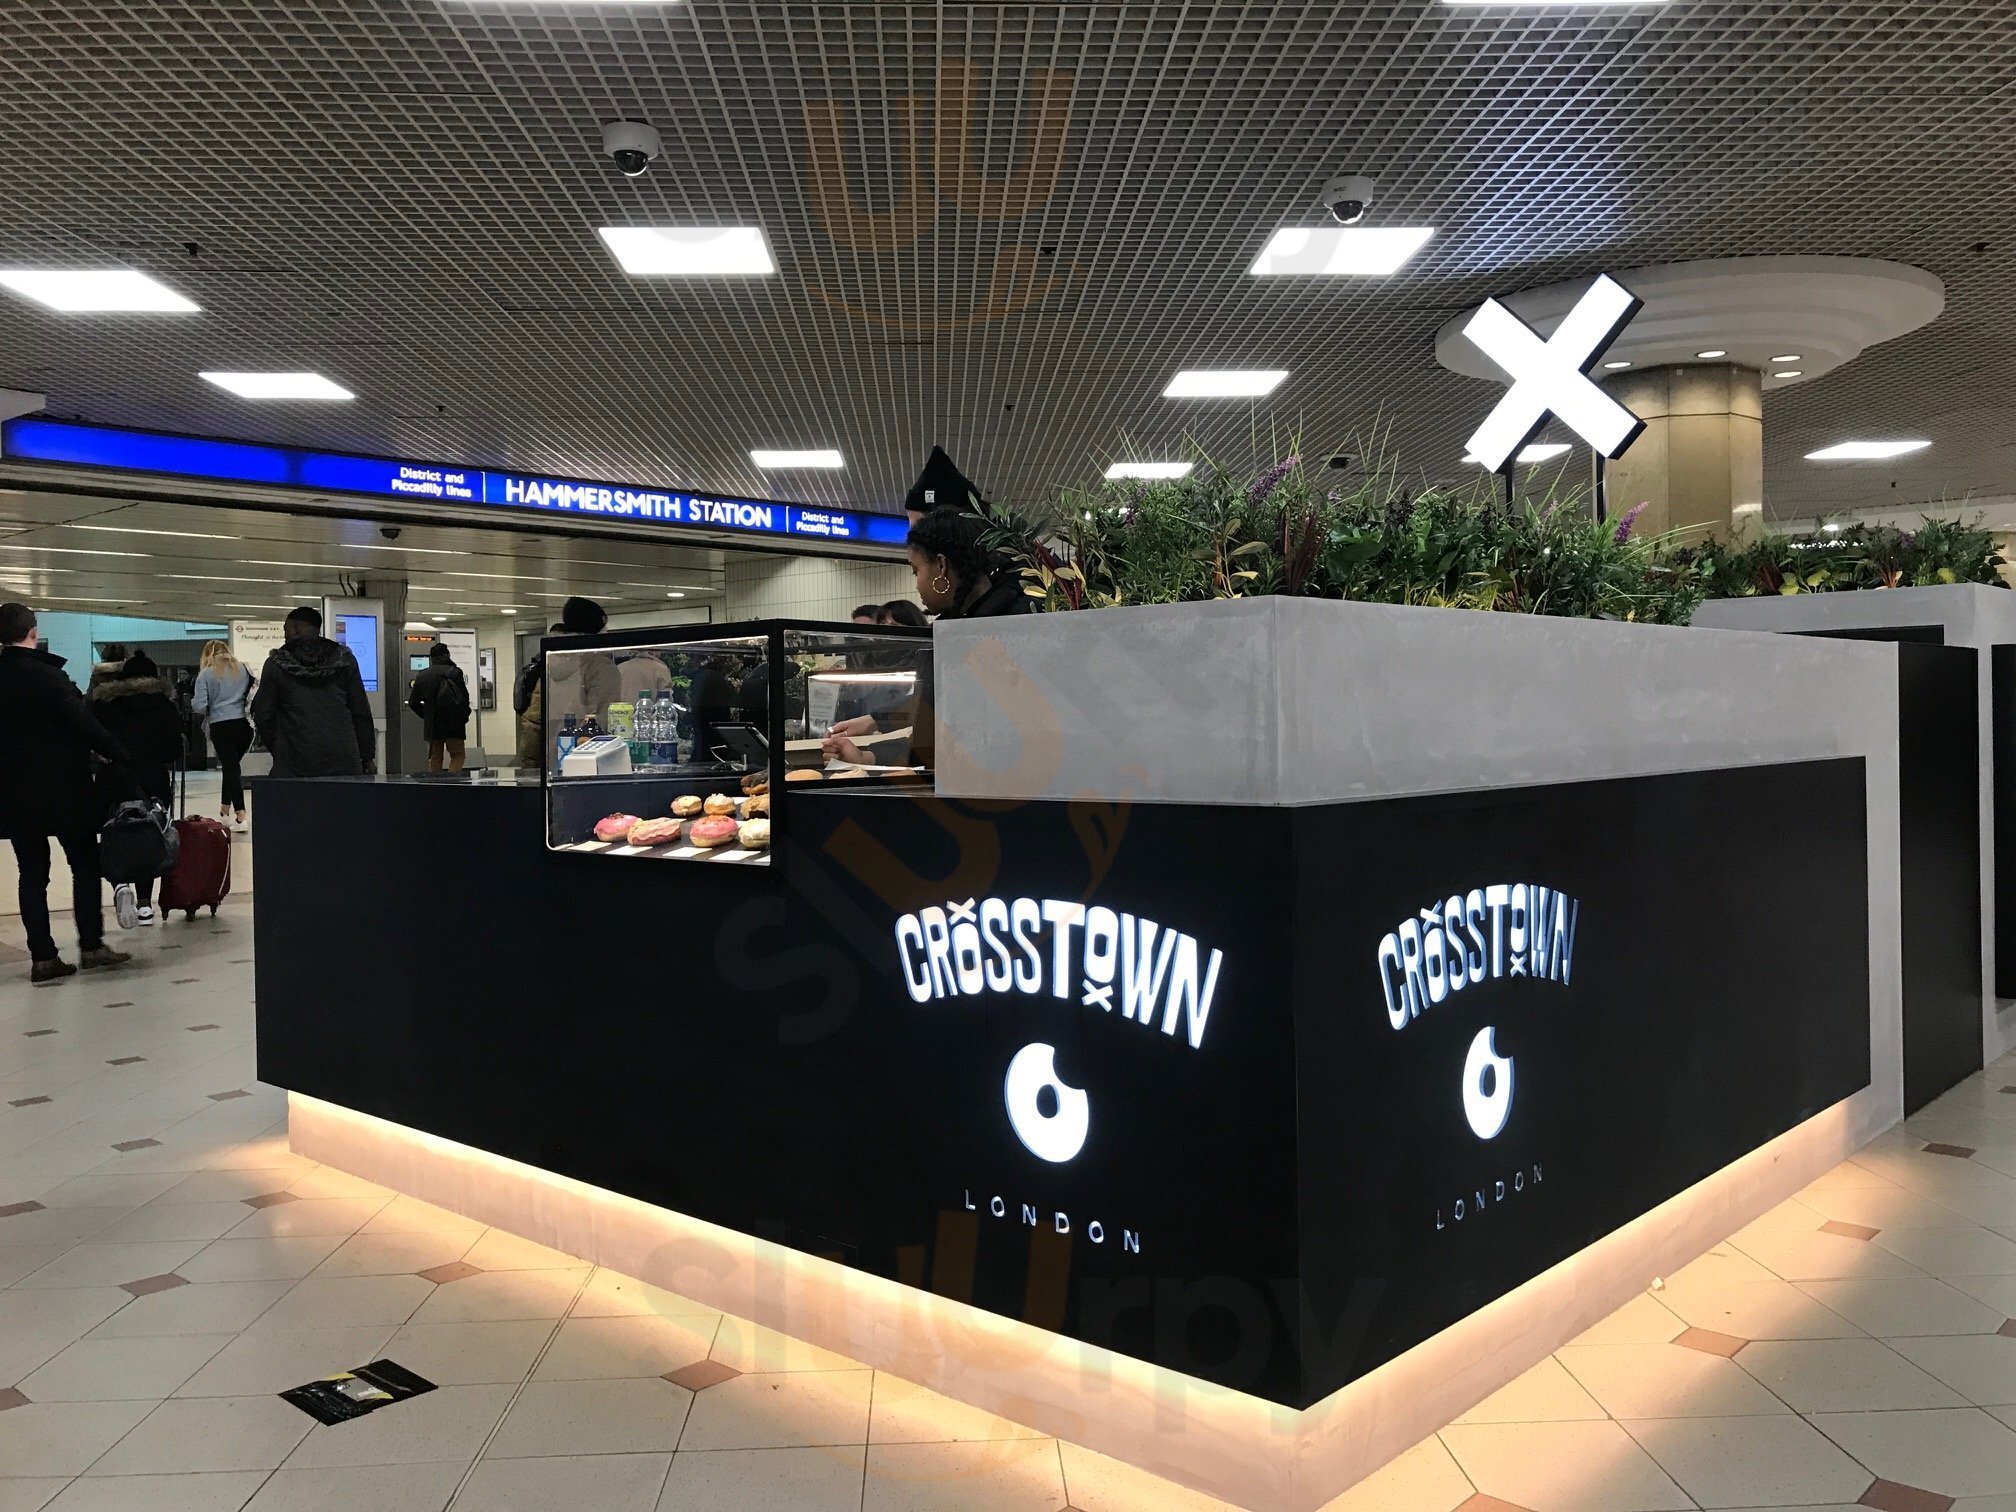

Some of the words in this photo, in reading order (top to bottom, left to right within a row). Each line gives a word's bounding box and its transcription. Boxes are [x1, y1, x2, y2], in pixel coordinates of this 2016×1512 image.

[391, 479, 443, 497] Piccadilly
[446, 484, 472, 498] lines
[400, 467, 442, 482] District
[445, 474, 464, 484] and
[506, 478, 681, 519] HAMMERSMITH
[689, 499, 772, 528] STATION
[801, 511, 829, 523] District
[831, 515, 844, 525] and
[796, 521, 830, 535] Piccadilly
[832, 524, 850, 536] lines
[895, 897, 1223, 1050] CROSSTOWN
[1377, 883, 1580, 1031] CROSSTOWN
[965, 1189, 1141, 1254] LONDON
[1436, 1163, 1544, 1231] LONDON
